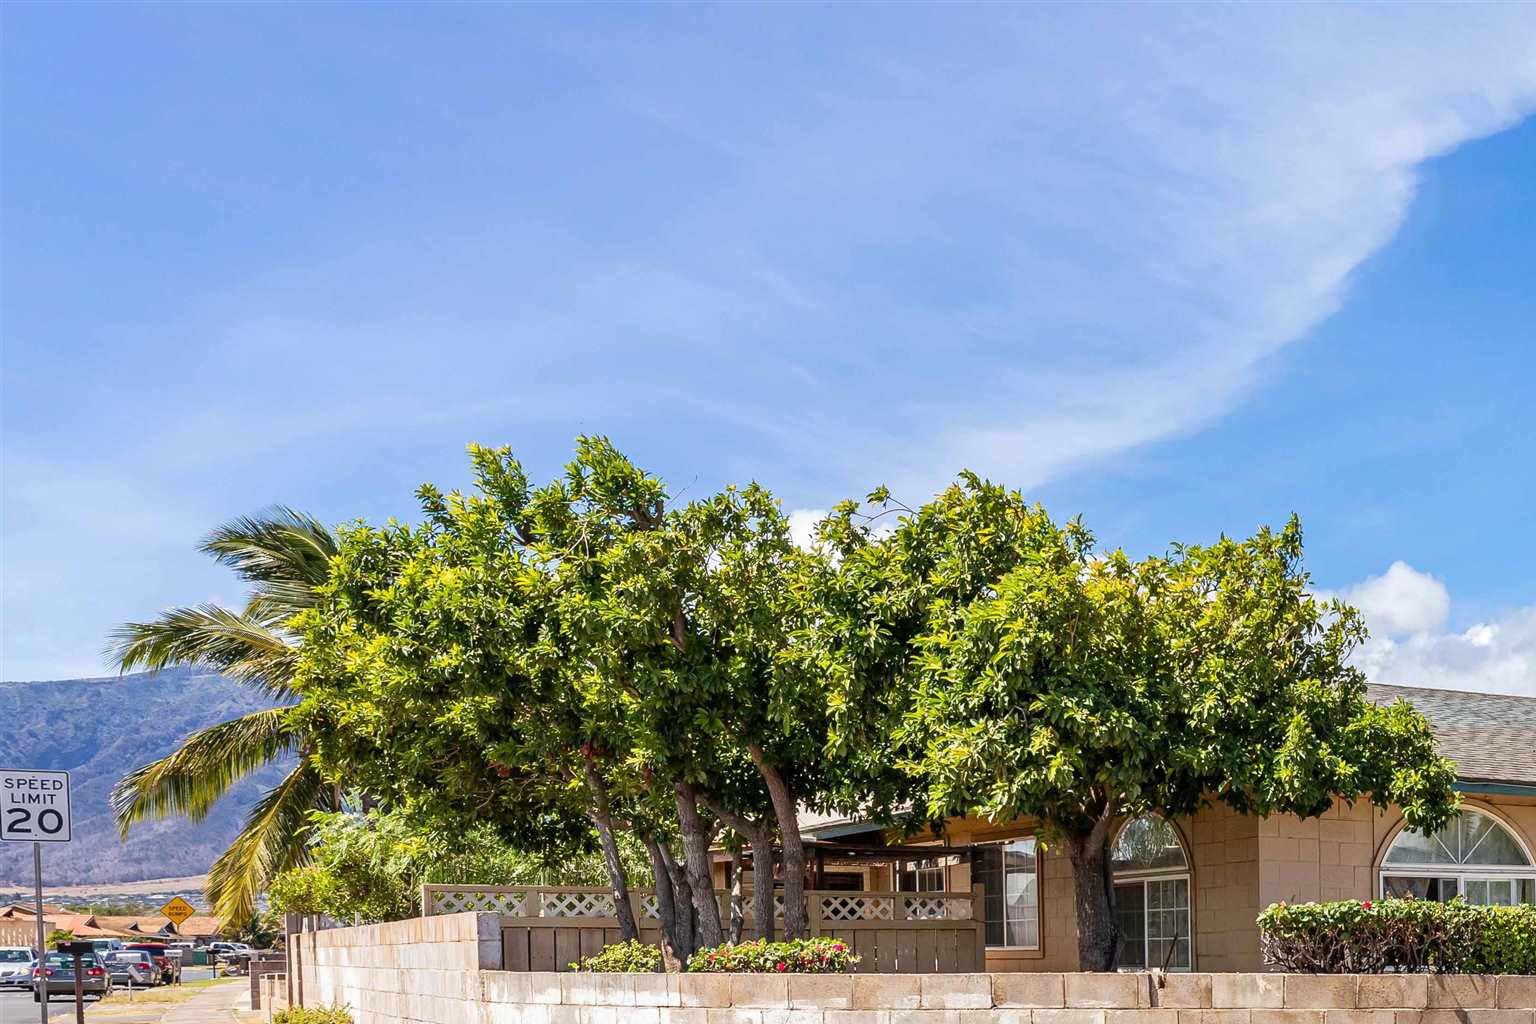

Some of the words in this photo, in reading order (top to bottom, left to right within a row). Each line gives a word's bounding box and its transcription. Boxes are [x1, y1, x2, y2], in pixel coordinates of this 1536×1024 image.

[4, 778, 63, 790] SPEED
[11, 793, 56, 804] LIMIT
[6, 808, 63, 834] 20
